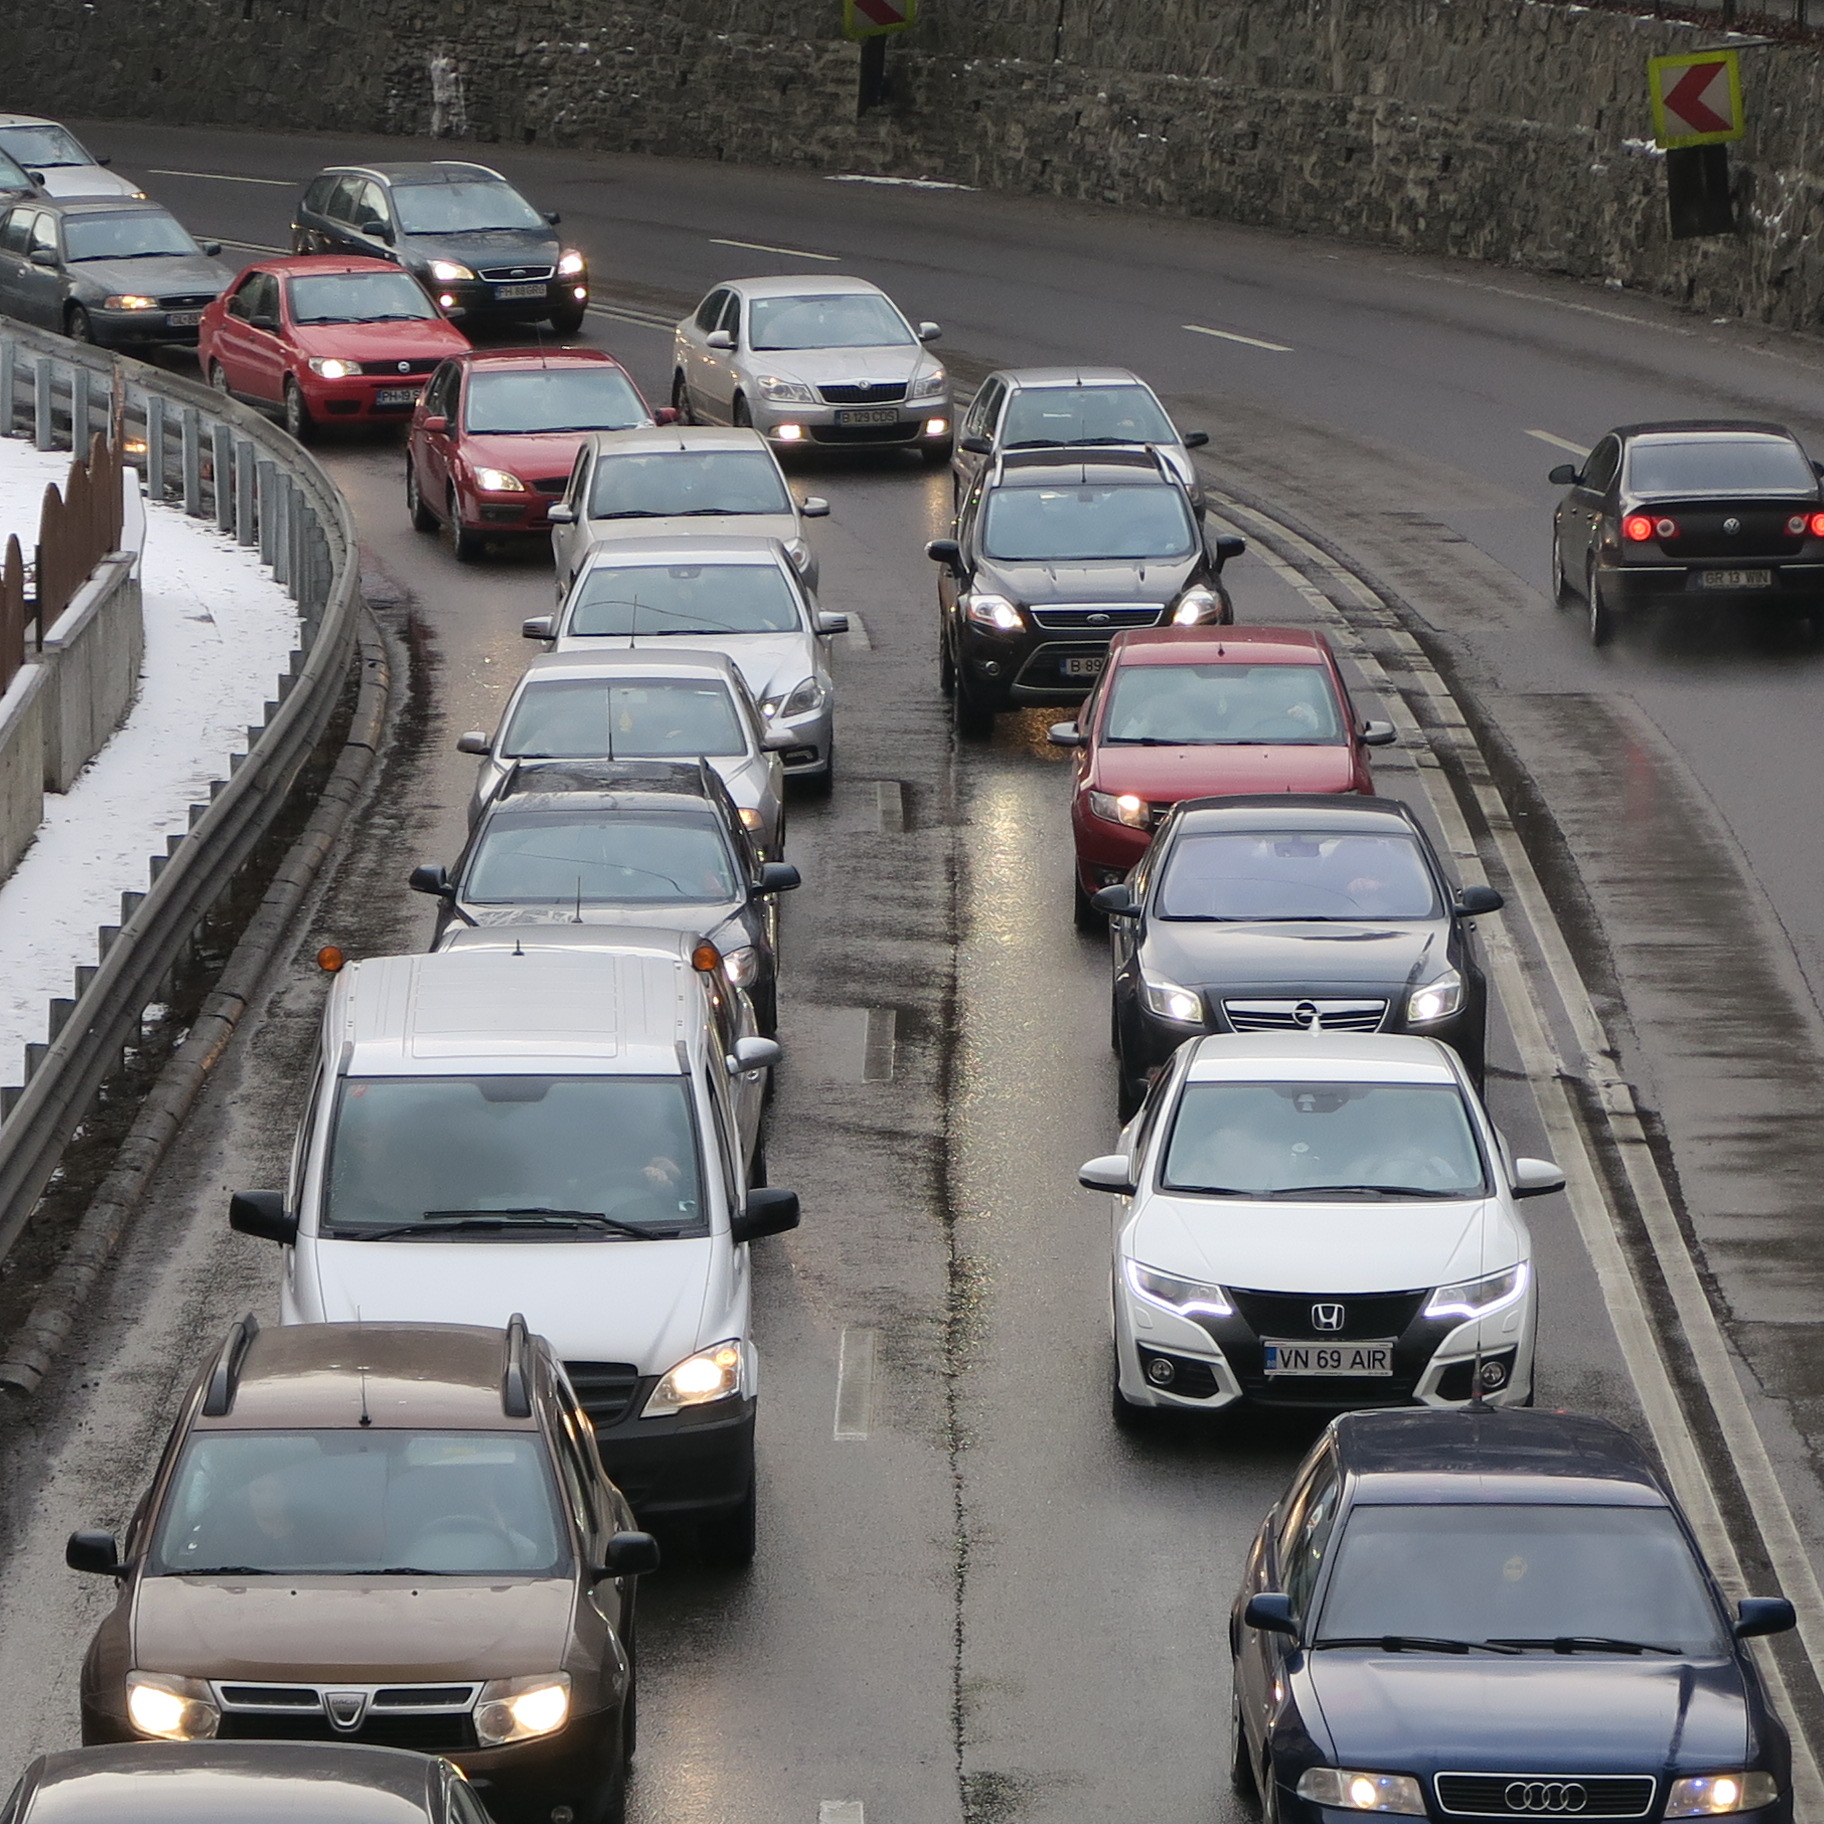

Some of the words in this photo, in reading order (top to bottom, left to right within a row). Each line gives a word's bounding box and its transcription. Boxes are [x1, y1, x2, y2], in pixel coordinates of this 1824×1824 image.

[1071, 660, 1081, 673] B
[1280, 1349, 1309, 1369] VN
[1316, 1349, 1342, 1369] 69
[1350, 1349, 1387, 1369] AIR
